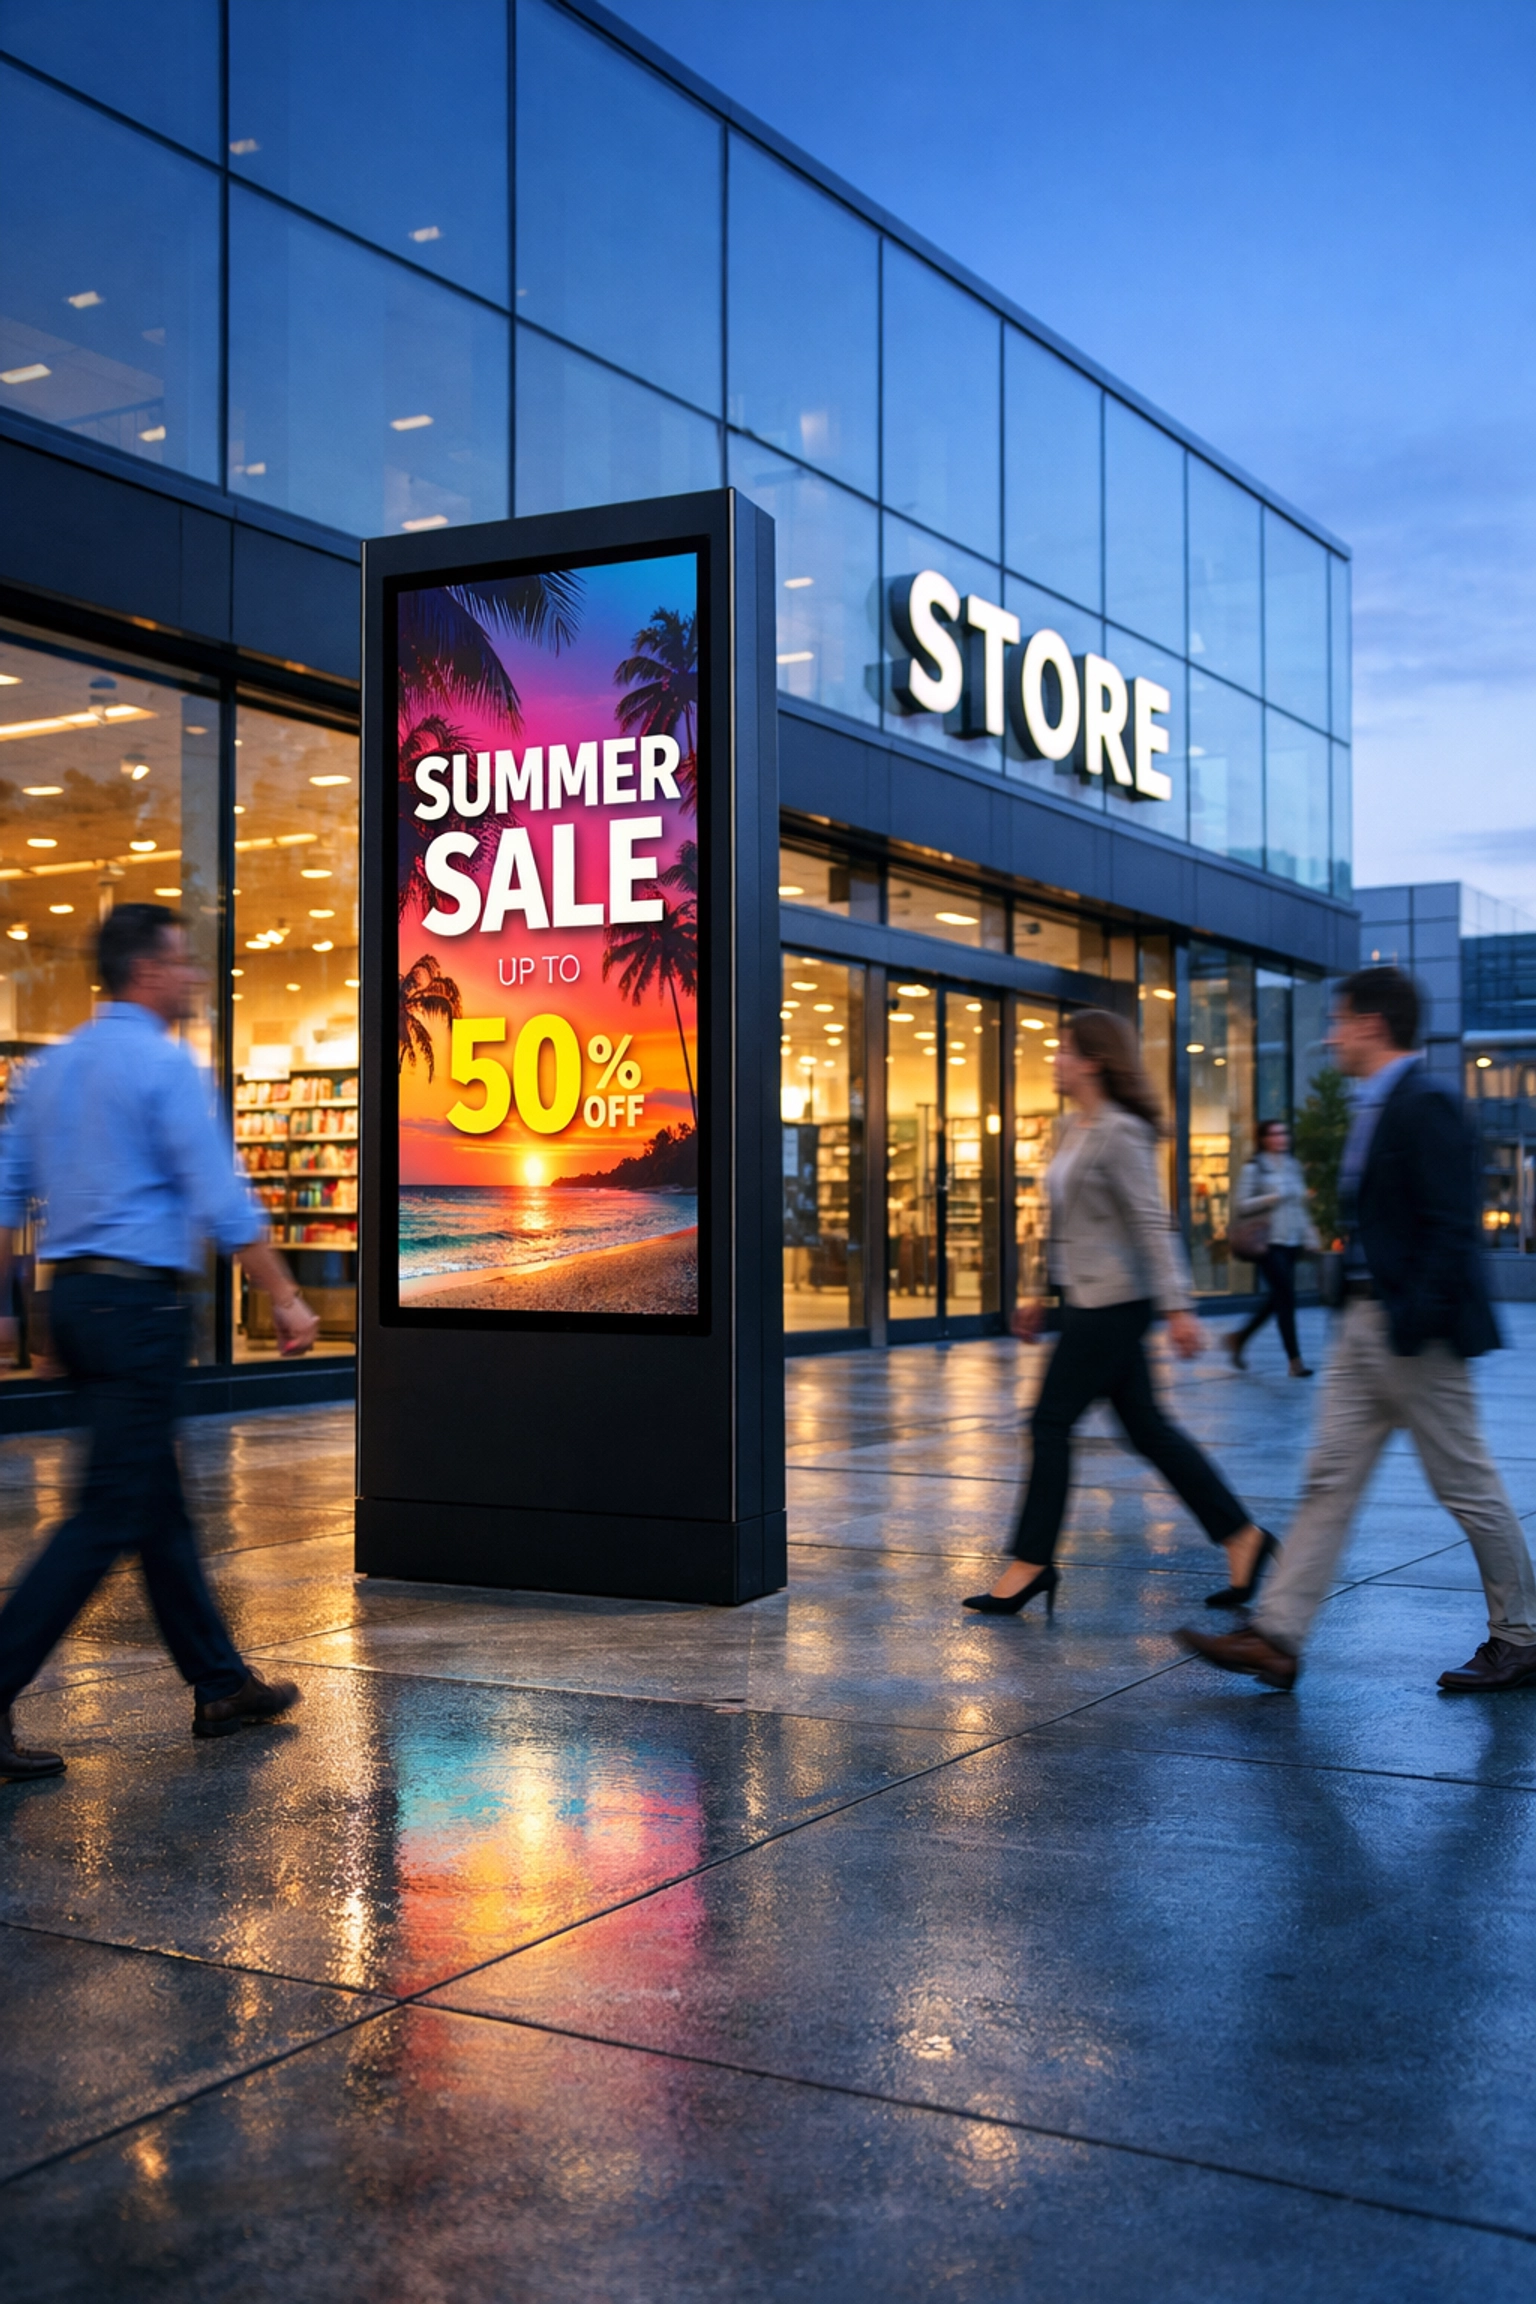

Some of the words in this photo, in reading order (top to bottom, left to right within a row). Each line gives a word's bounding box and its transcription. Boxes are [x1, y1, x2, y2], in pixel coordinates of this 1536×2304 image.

[909, 569, 1172, 801] STORE
[413, 734, 681, 820] SUMMER
[421, 815, 664, 937] SALE
[497, 957, 535, 986] UP
[542, 953, 580, 984] TO
[583, 1094, 644, 1128] OFF
